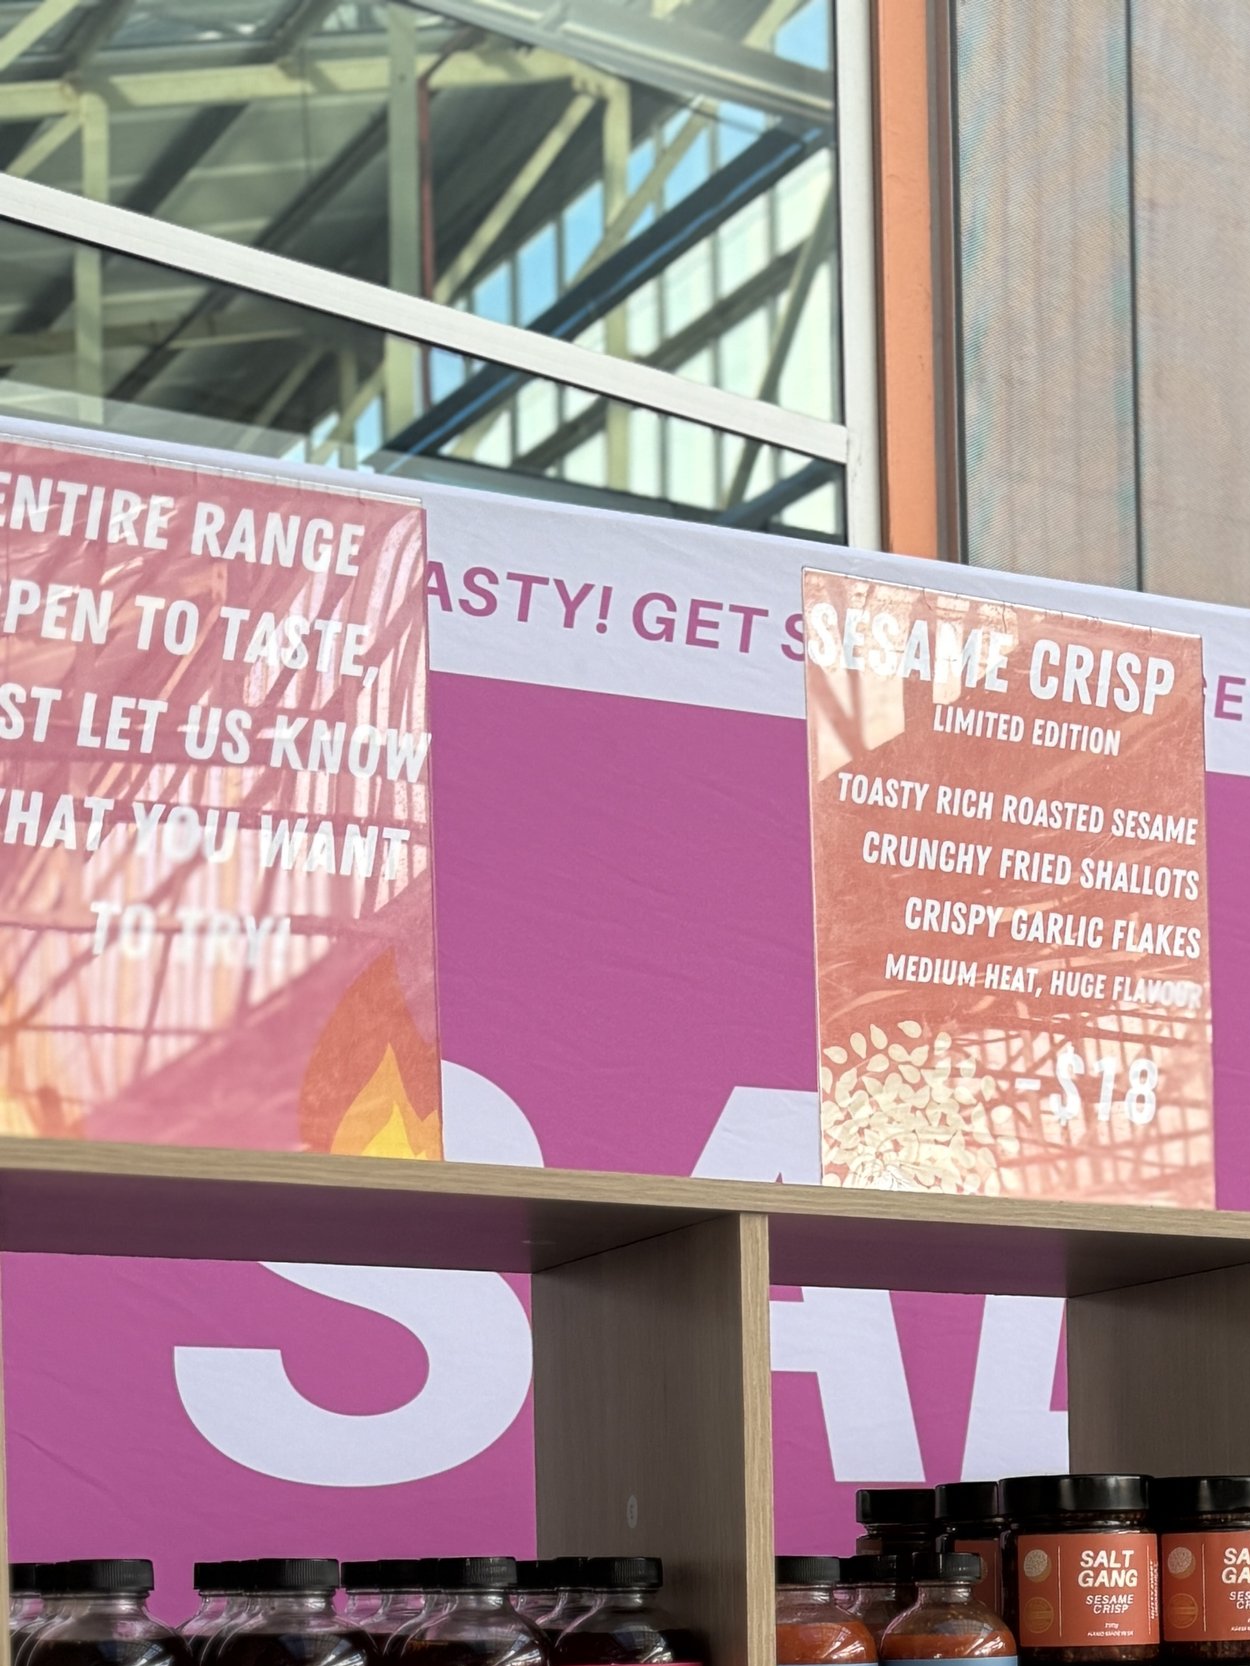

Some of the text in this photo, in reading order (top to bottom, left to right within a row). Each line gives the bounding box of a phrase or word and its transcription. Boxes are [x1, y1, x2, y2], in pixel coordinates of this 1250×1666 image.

[191, 502, 365, 576] RANGE
[2, 580, 379, 688] PEN TO TASTE,
[426, 561, 613, 634] ASTY!
[632, 592, 768, 653] GET
[806, 602, 1014, 694] SESAME
[1029, 639, 1175, 715] CRISP
[76, 692, 167, 754] LET
[183, 705, 252, 765] US
[270, 715, 430, 783] KNOW
[933, 705, 1120, 756] LIMITED EDITION
[0, 788, 410, 881] HAT YOU WANT
[838, 772, 1198, 846] TOASTY RICH ROASTED SESAME
[863, 831, 1199, 901] CRUNCHY FRIED SHALLOTS
[90, 902, 154, 957] TO
[904, 896, 1201, 959] CRISPY GARLIC FLAKES
[884, 954, 977, 988] MEDIUM
[984, 964, 1042, 997] HEAT,
[1050, 969, 1106, 1000] HUGE
[1078, 1569, 1138, 1589] GANG
[1080, 1550, 1135, 1568] SALT
[1086, 1595, 1134, 1605] SESAME
[1093, 1604, 1129, 1614] CRISP
